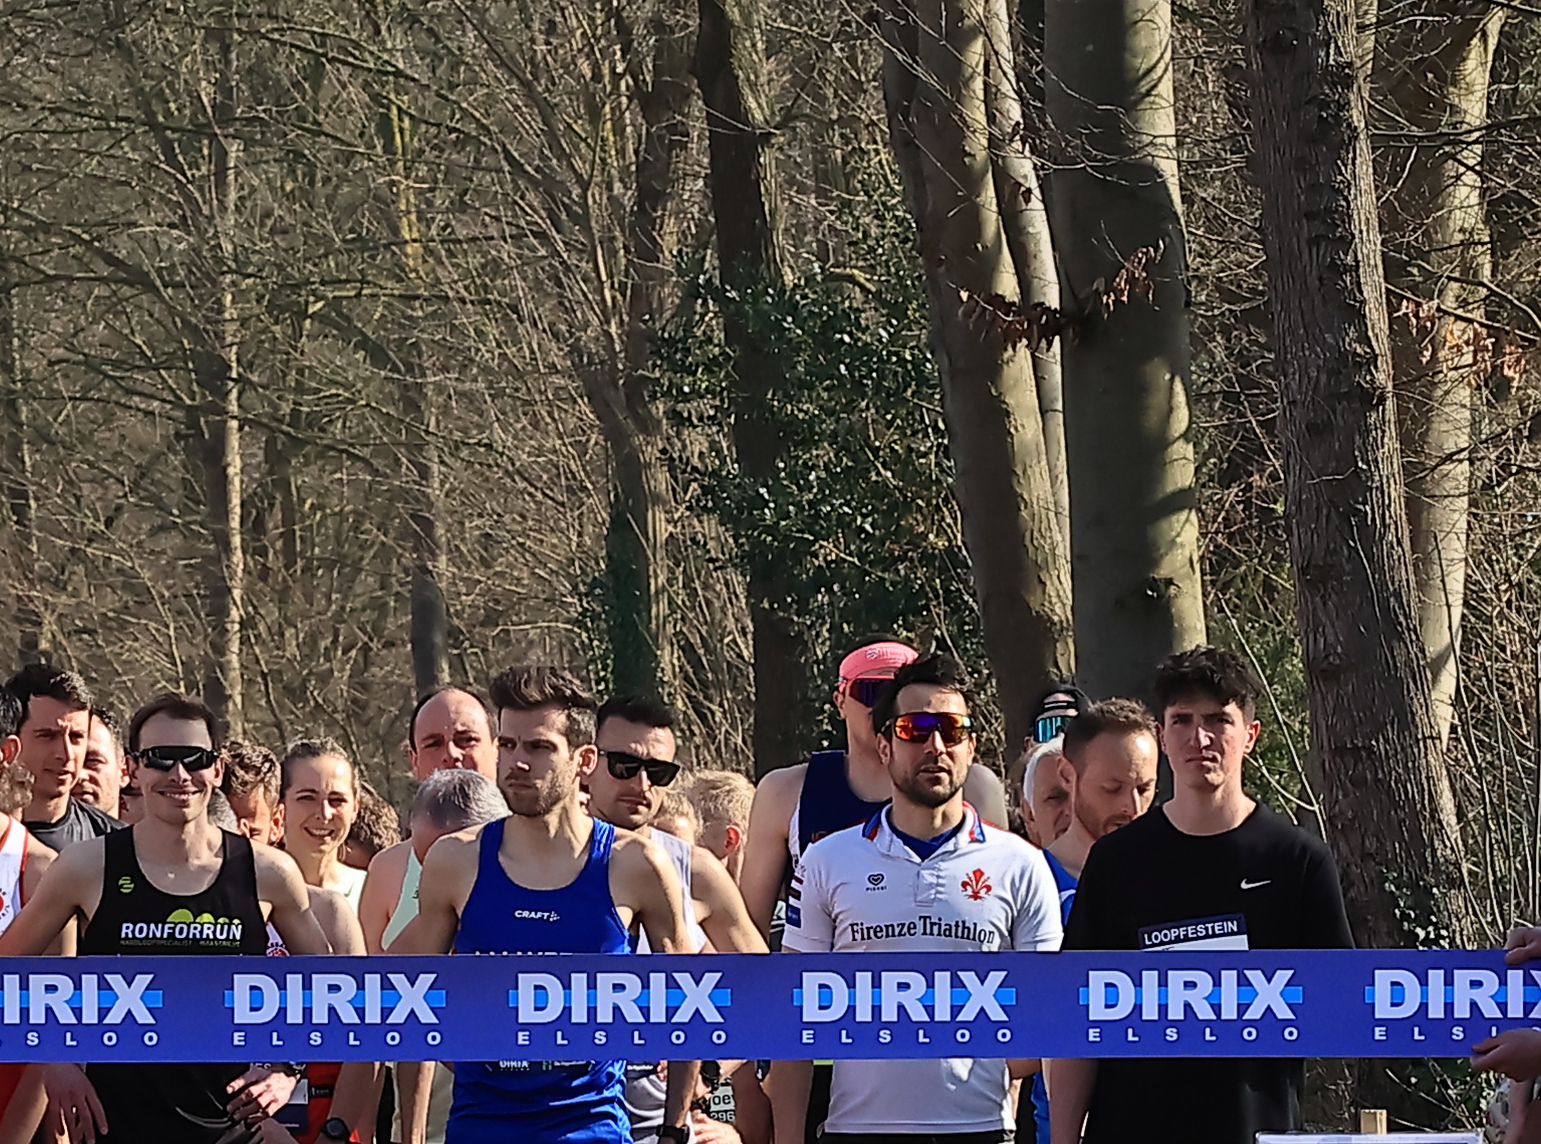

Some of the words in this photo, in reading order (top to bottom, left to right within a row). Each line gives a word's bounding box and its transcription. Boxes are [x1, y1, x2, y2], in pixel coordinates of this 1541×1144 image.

[514, 910, 549, 920] CRAFT
[120, 922, 243, 940] RONFORRUN
[849, 922, 918, 943] Firenze
[918, 915, 996, 945] Triathlon
[1144, 920, 1238, 945] LOOPFESTEIN
[234, 973, 439, 1024] DIRIX
[518, 972, 724, 1023] DIRIX
[803, 971, 1009, 1022] DIRIX
[1089, 970, 1295, 1021] DIRIX
[1374, 969, 1541, 1019] DIRI
[234, 1031, 441, 1046] ELSLOO
[518, 1030, 726, 1045] ELSLOO
[803, 1028, 1011, 1043] ELSLOO
[1089, 1027, 1298, 1042] ELSLOO
